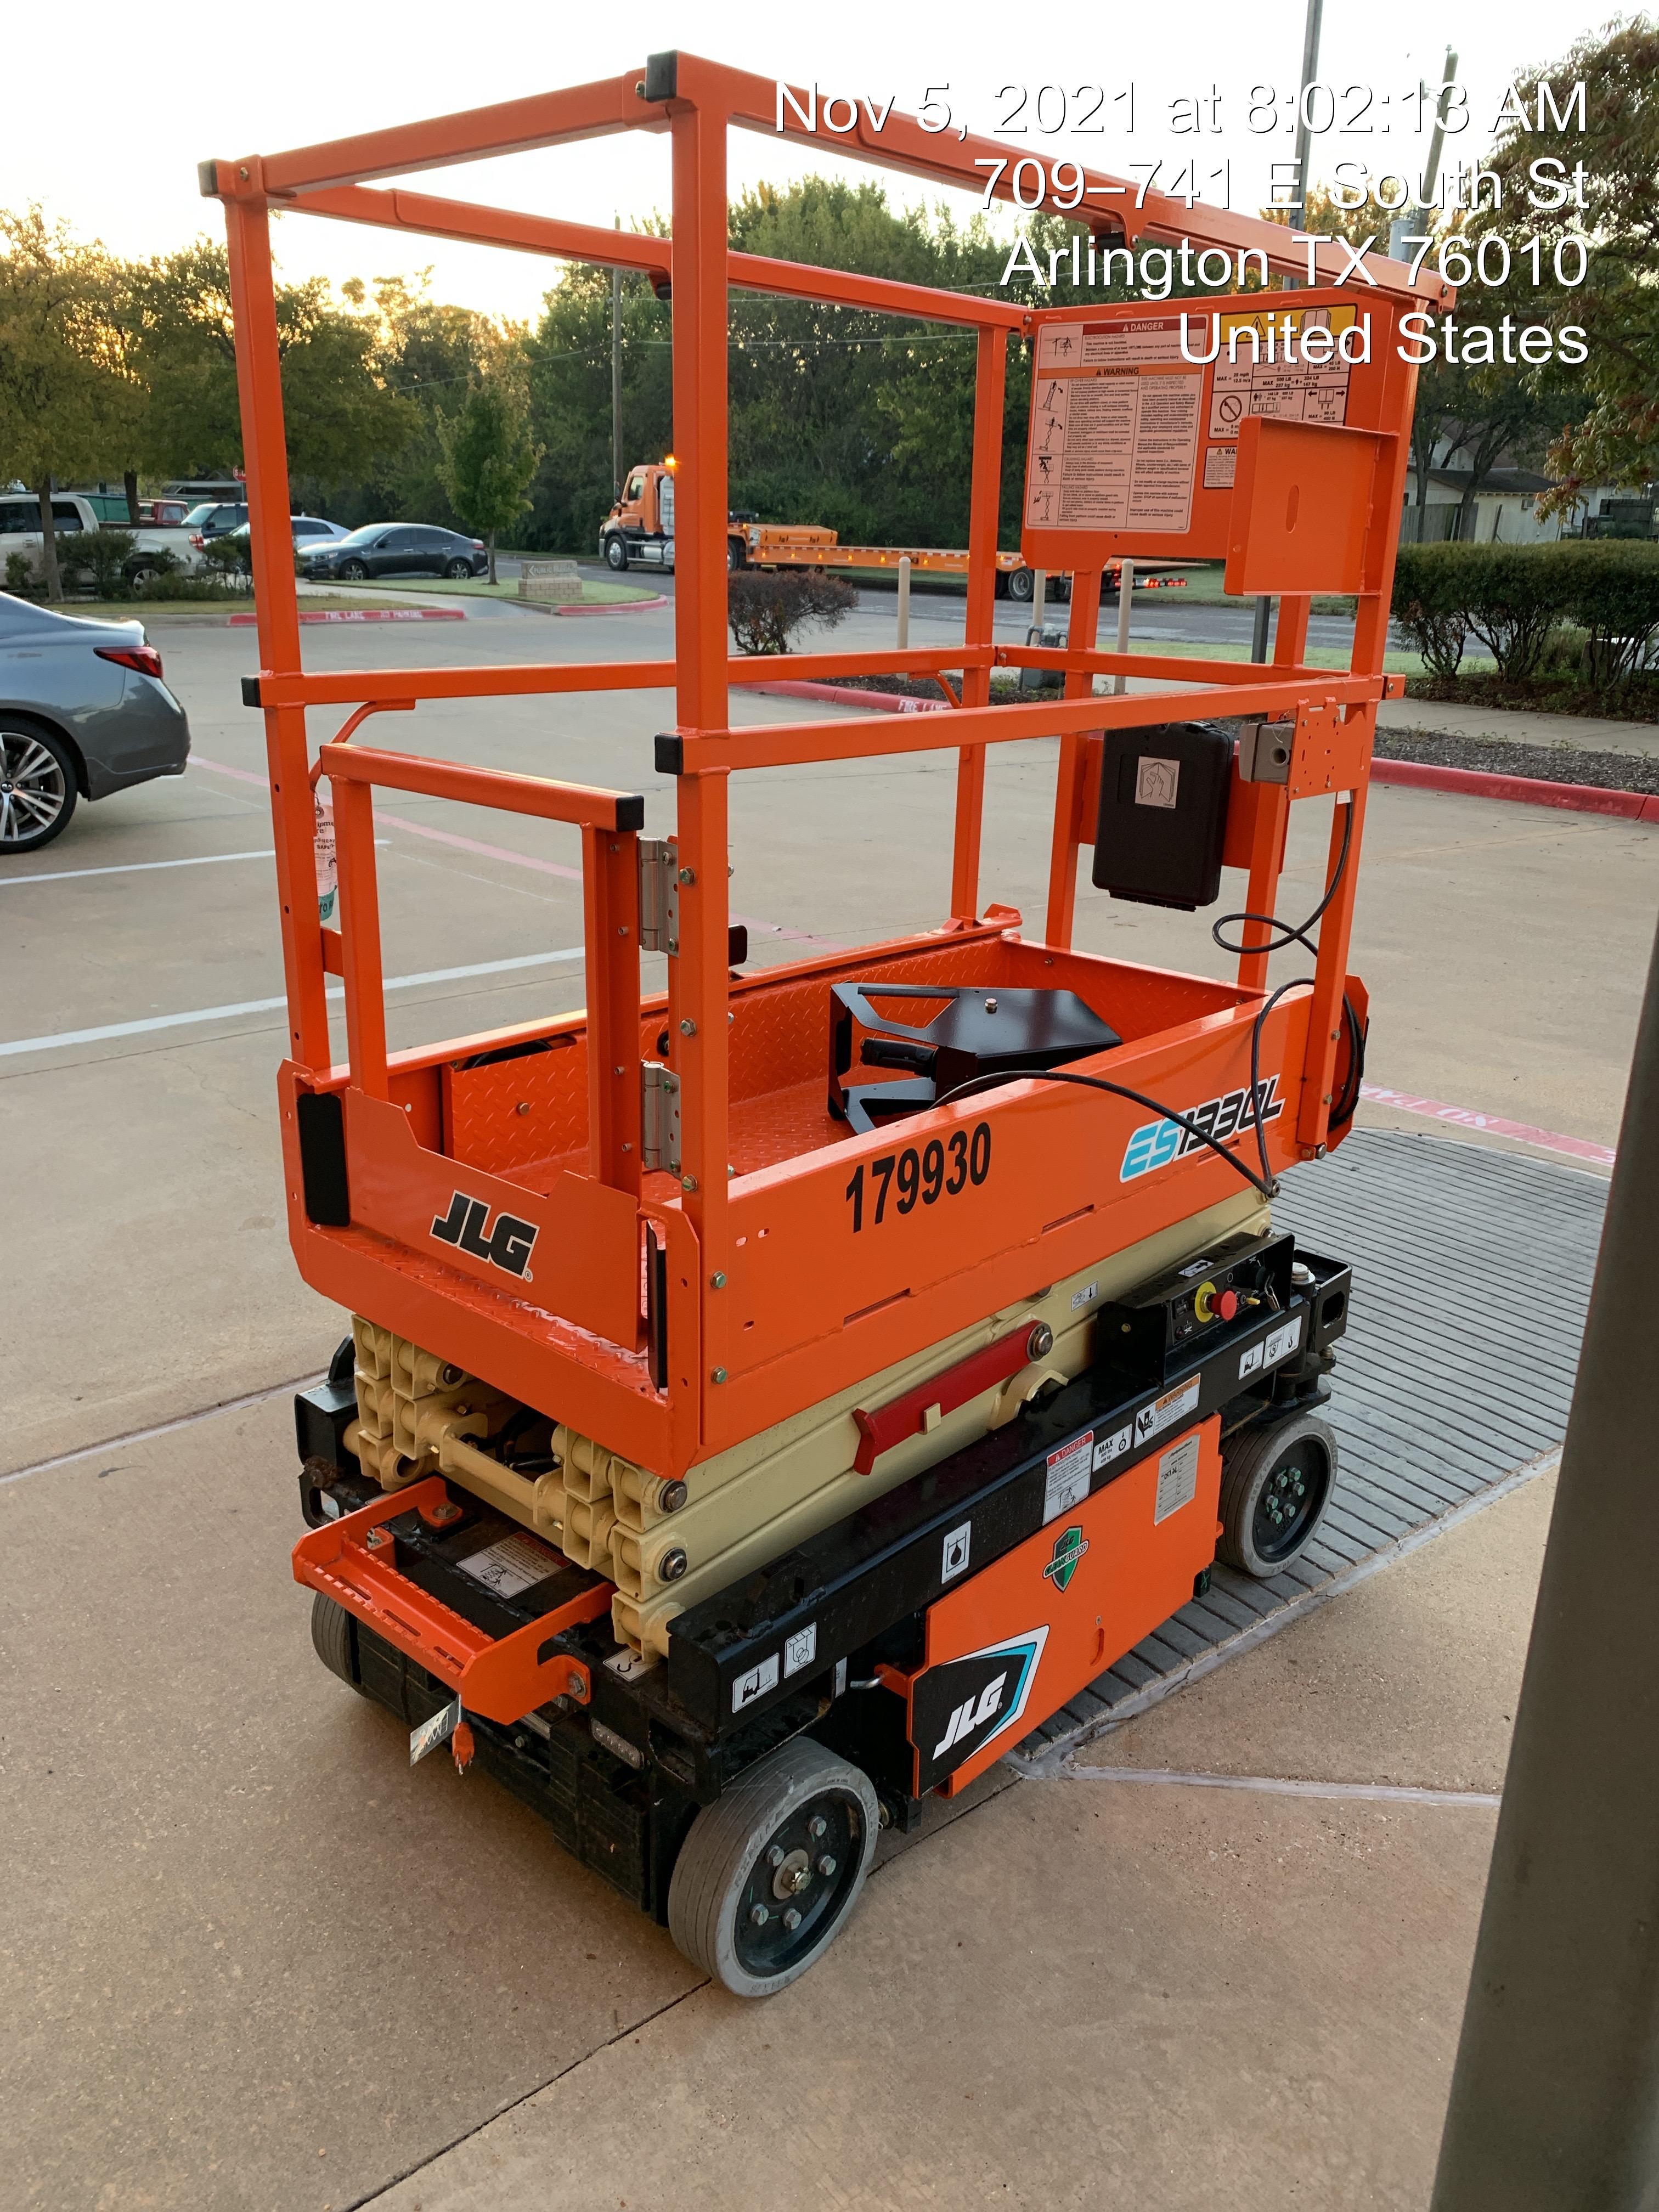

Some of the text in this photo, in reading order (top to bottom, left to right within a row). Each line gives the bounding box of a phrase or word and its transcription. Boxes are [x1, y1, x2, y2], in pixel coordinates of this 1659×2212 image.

[1131, 322, 1164, 331] DANGER
[1103, 367, 1139, 375] WARNING
[325, 611, 341, 620] FIRE
[345, 611, 365, 619] LANE
[898, 699, 919, 713] FIRE
[846, 1121, 991, 1234] 179930
[430, 1189, 540, 1280] JLG
[1062, 1437, 1086, 1458] DANGER
[1098, 1438, 1113, 1454] MAX
[1060, 1535, 1075, 1551] JLG
[1045, 1542, 1088, 1577] CLEANGUARD
[933, 1671, 1007, 1760] JLG
